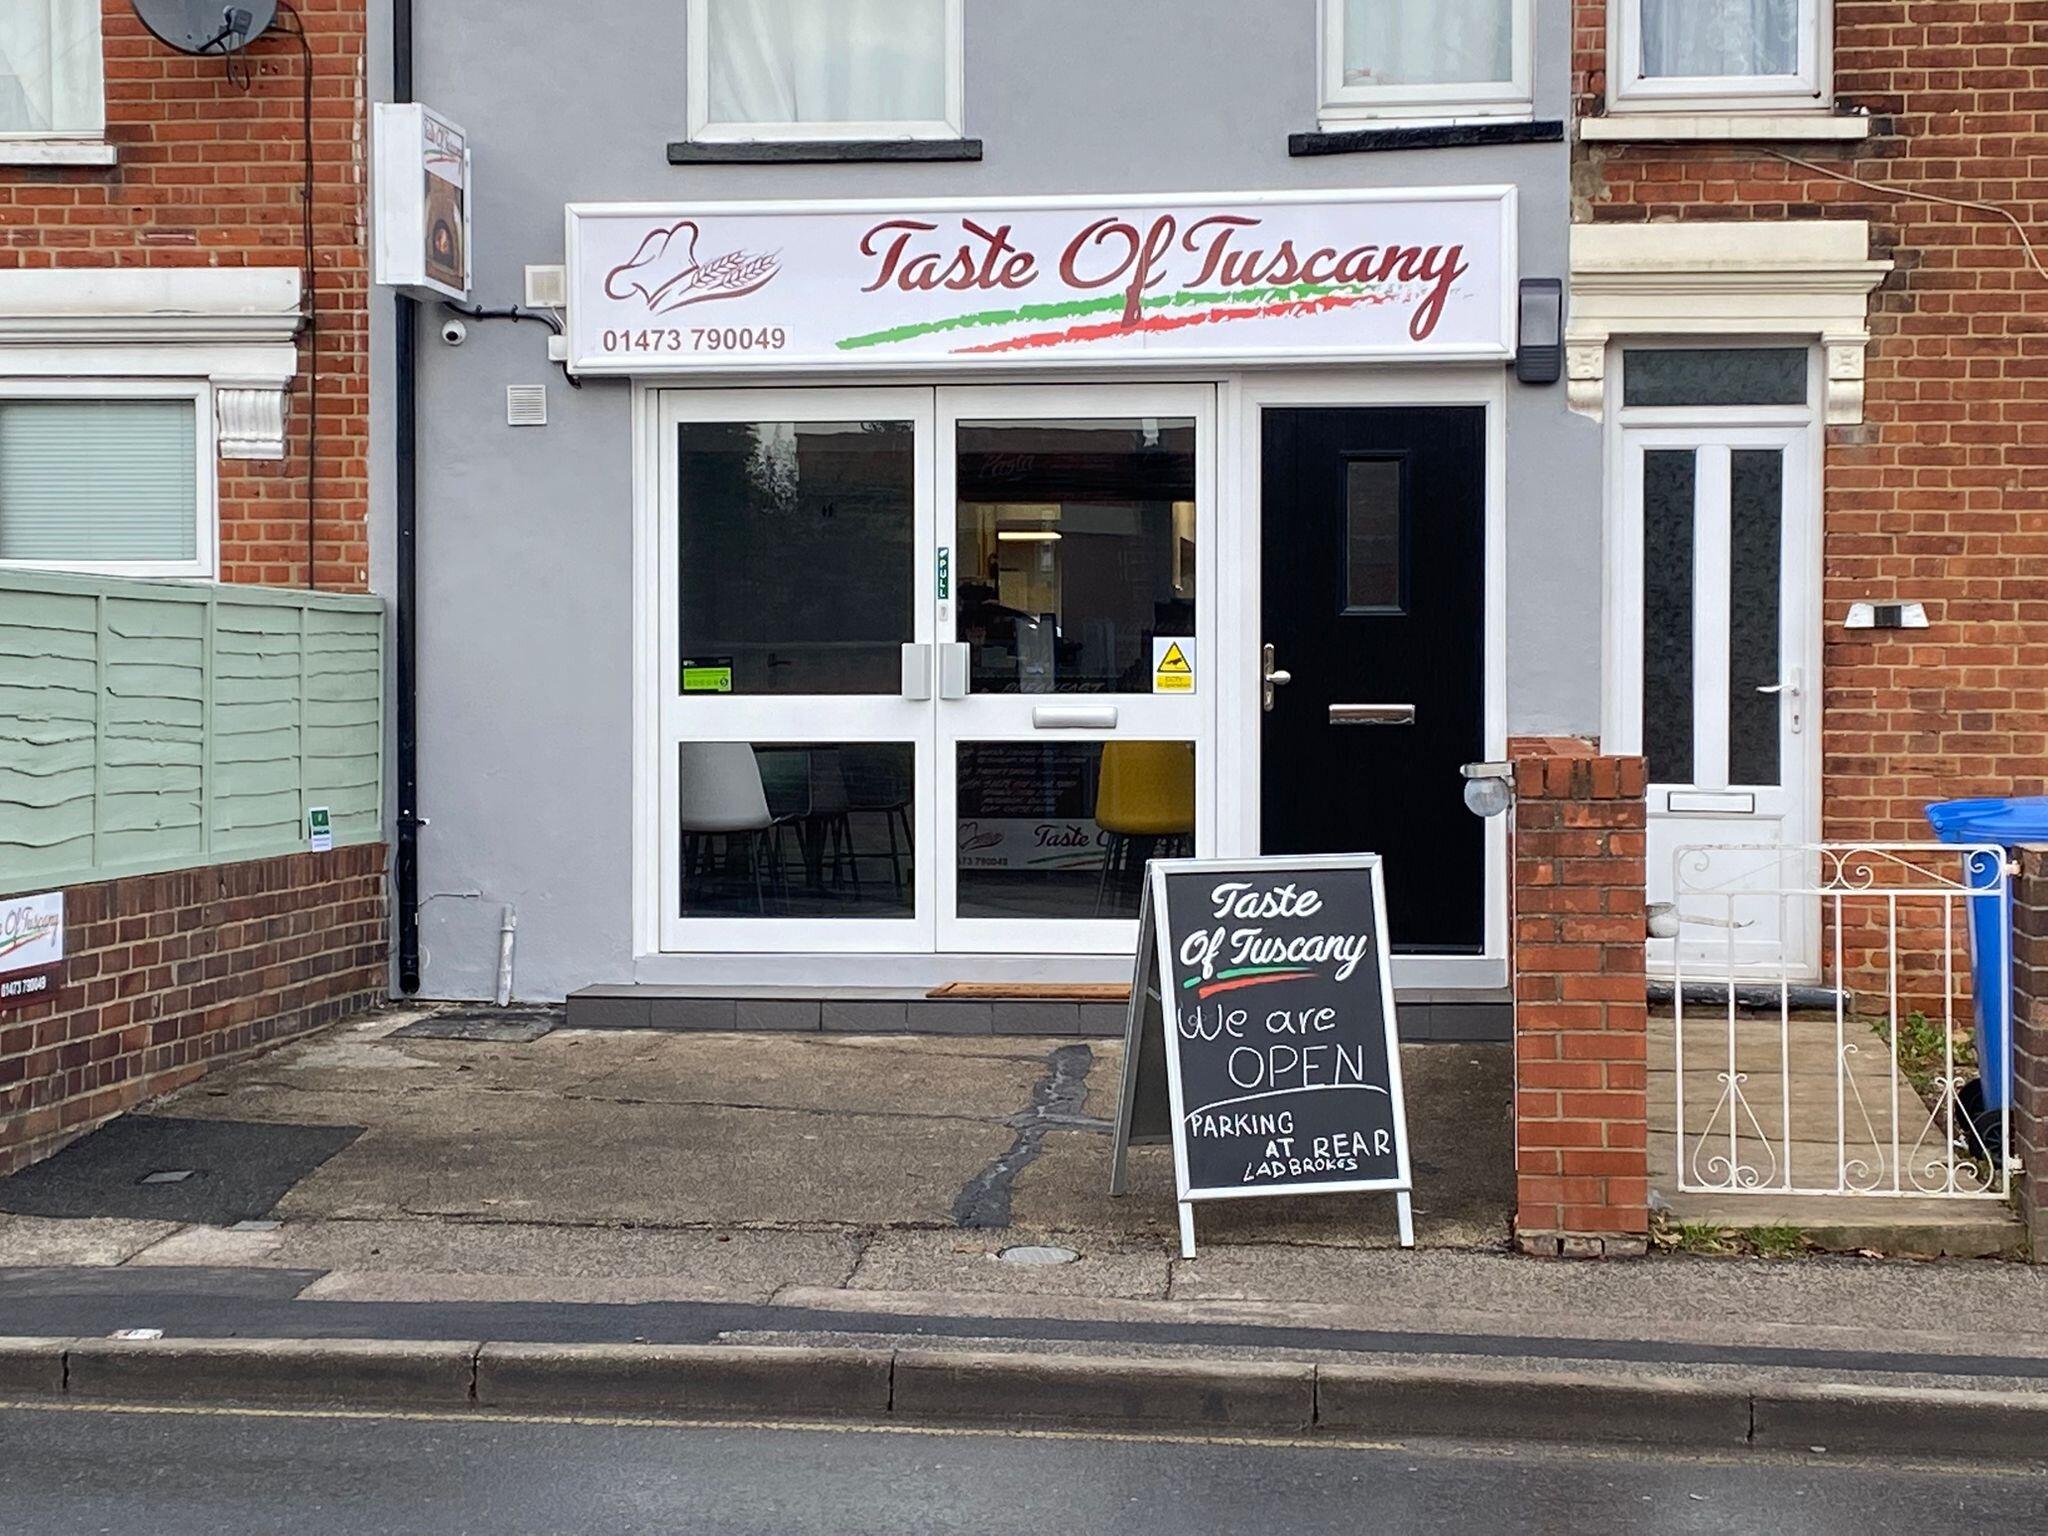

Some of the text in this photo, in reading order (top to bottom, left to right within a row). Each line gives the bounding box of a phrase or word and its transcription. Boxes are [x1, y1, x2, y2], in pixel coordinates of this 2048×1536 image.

[860, 213, 1469, 341] Taste Of Tuscany
[602, 327, 786, 353] 01473 790049
[939, 559, 948, 598] PULL
[1034, 824, 1091, 848] Taste
[1211, 882, 1323, 919] Taste
[1179, 926, 1368, 982] Of Tuscany
[1177, 1003, 1336, 1041] We are
[1228, 1044, 1365, 1089] OPEN
[1191, 1111, 1294, 1138] PARKING
[1265, 1129, 1391, 1158] AT REAR
